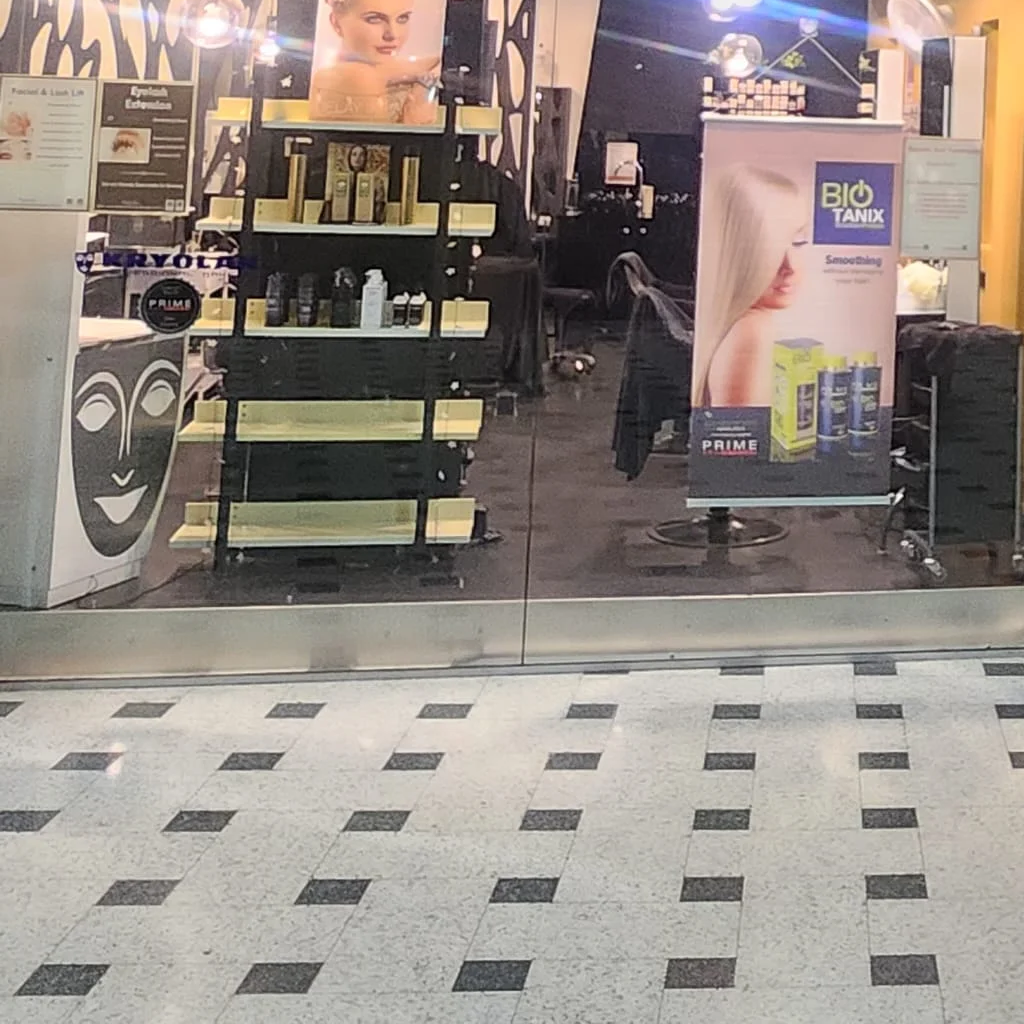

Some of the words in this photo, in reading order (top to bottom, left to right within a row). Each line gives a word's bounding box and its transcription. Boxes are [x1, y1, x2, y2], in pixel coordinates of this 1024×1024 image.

[821, 179, 874, 209] BIO
[832, 208, 885, 224] TANIX
[825, 255, 882, 268] Smoothing
[149, 299, 192, 311] PRIME
[702, 439, 758, 451] PRIME
